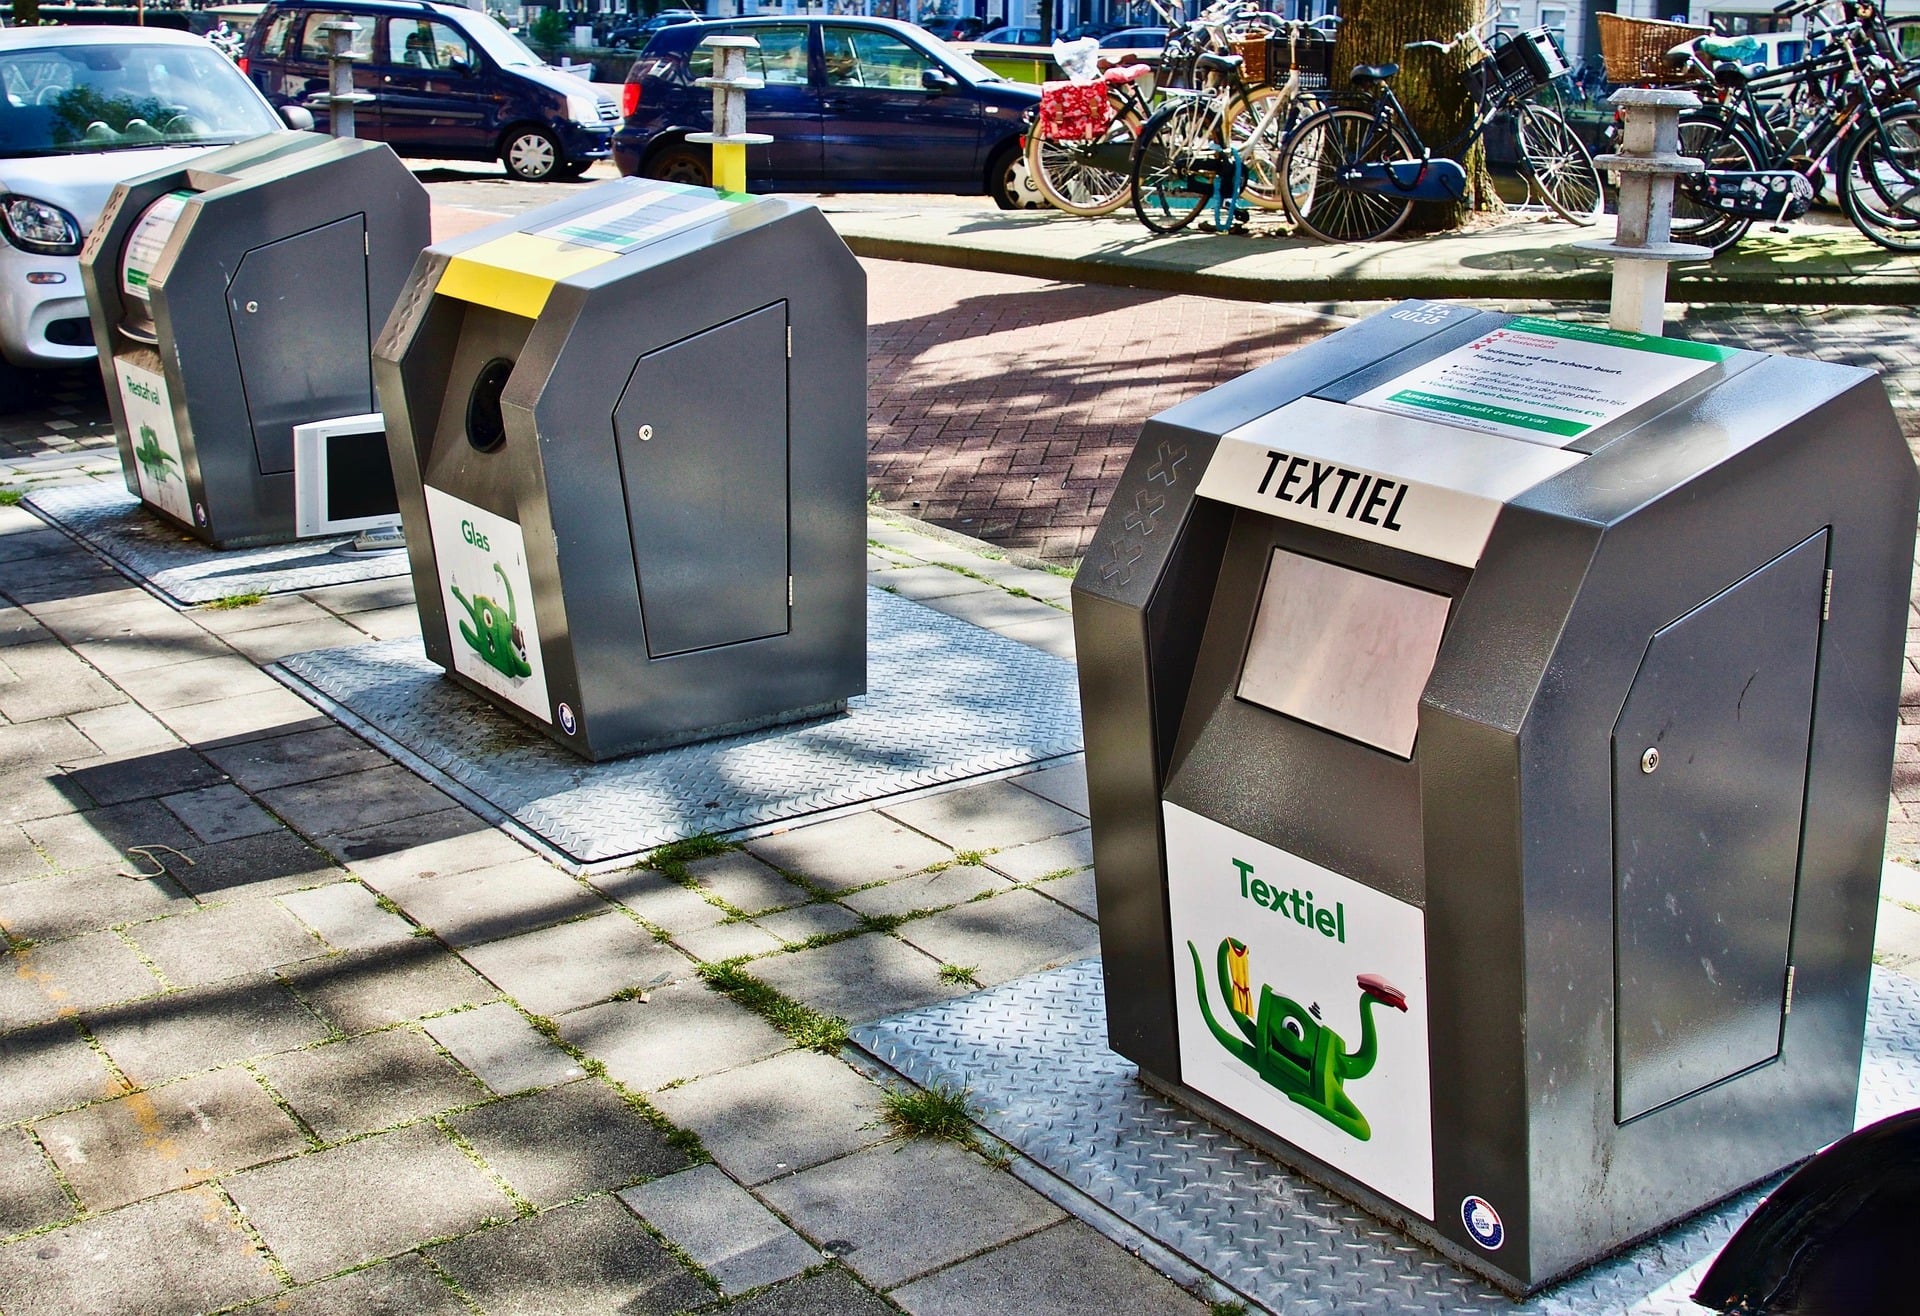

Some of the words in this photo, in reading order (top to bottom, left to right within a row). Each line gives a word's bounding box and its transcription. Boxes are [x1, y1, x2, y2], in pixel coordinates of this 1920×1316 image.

[1390, 309, 1447, 325] 0035
[1257, 450, 1409, 532] TEXTIEL
[461, 519, 490, 552] Glas
[1232, 857, 1345, 944] Textiel
